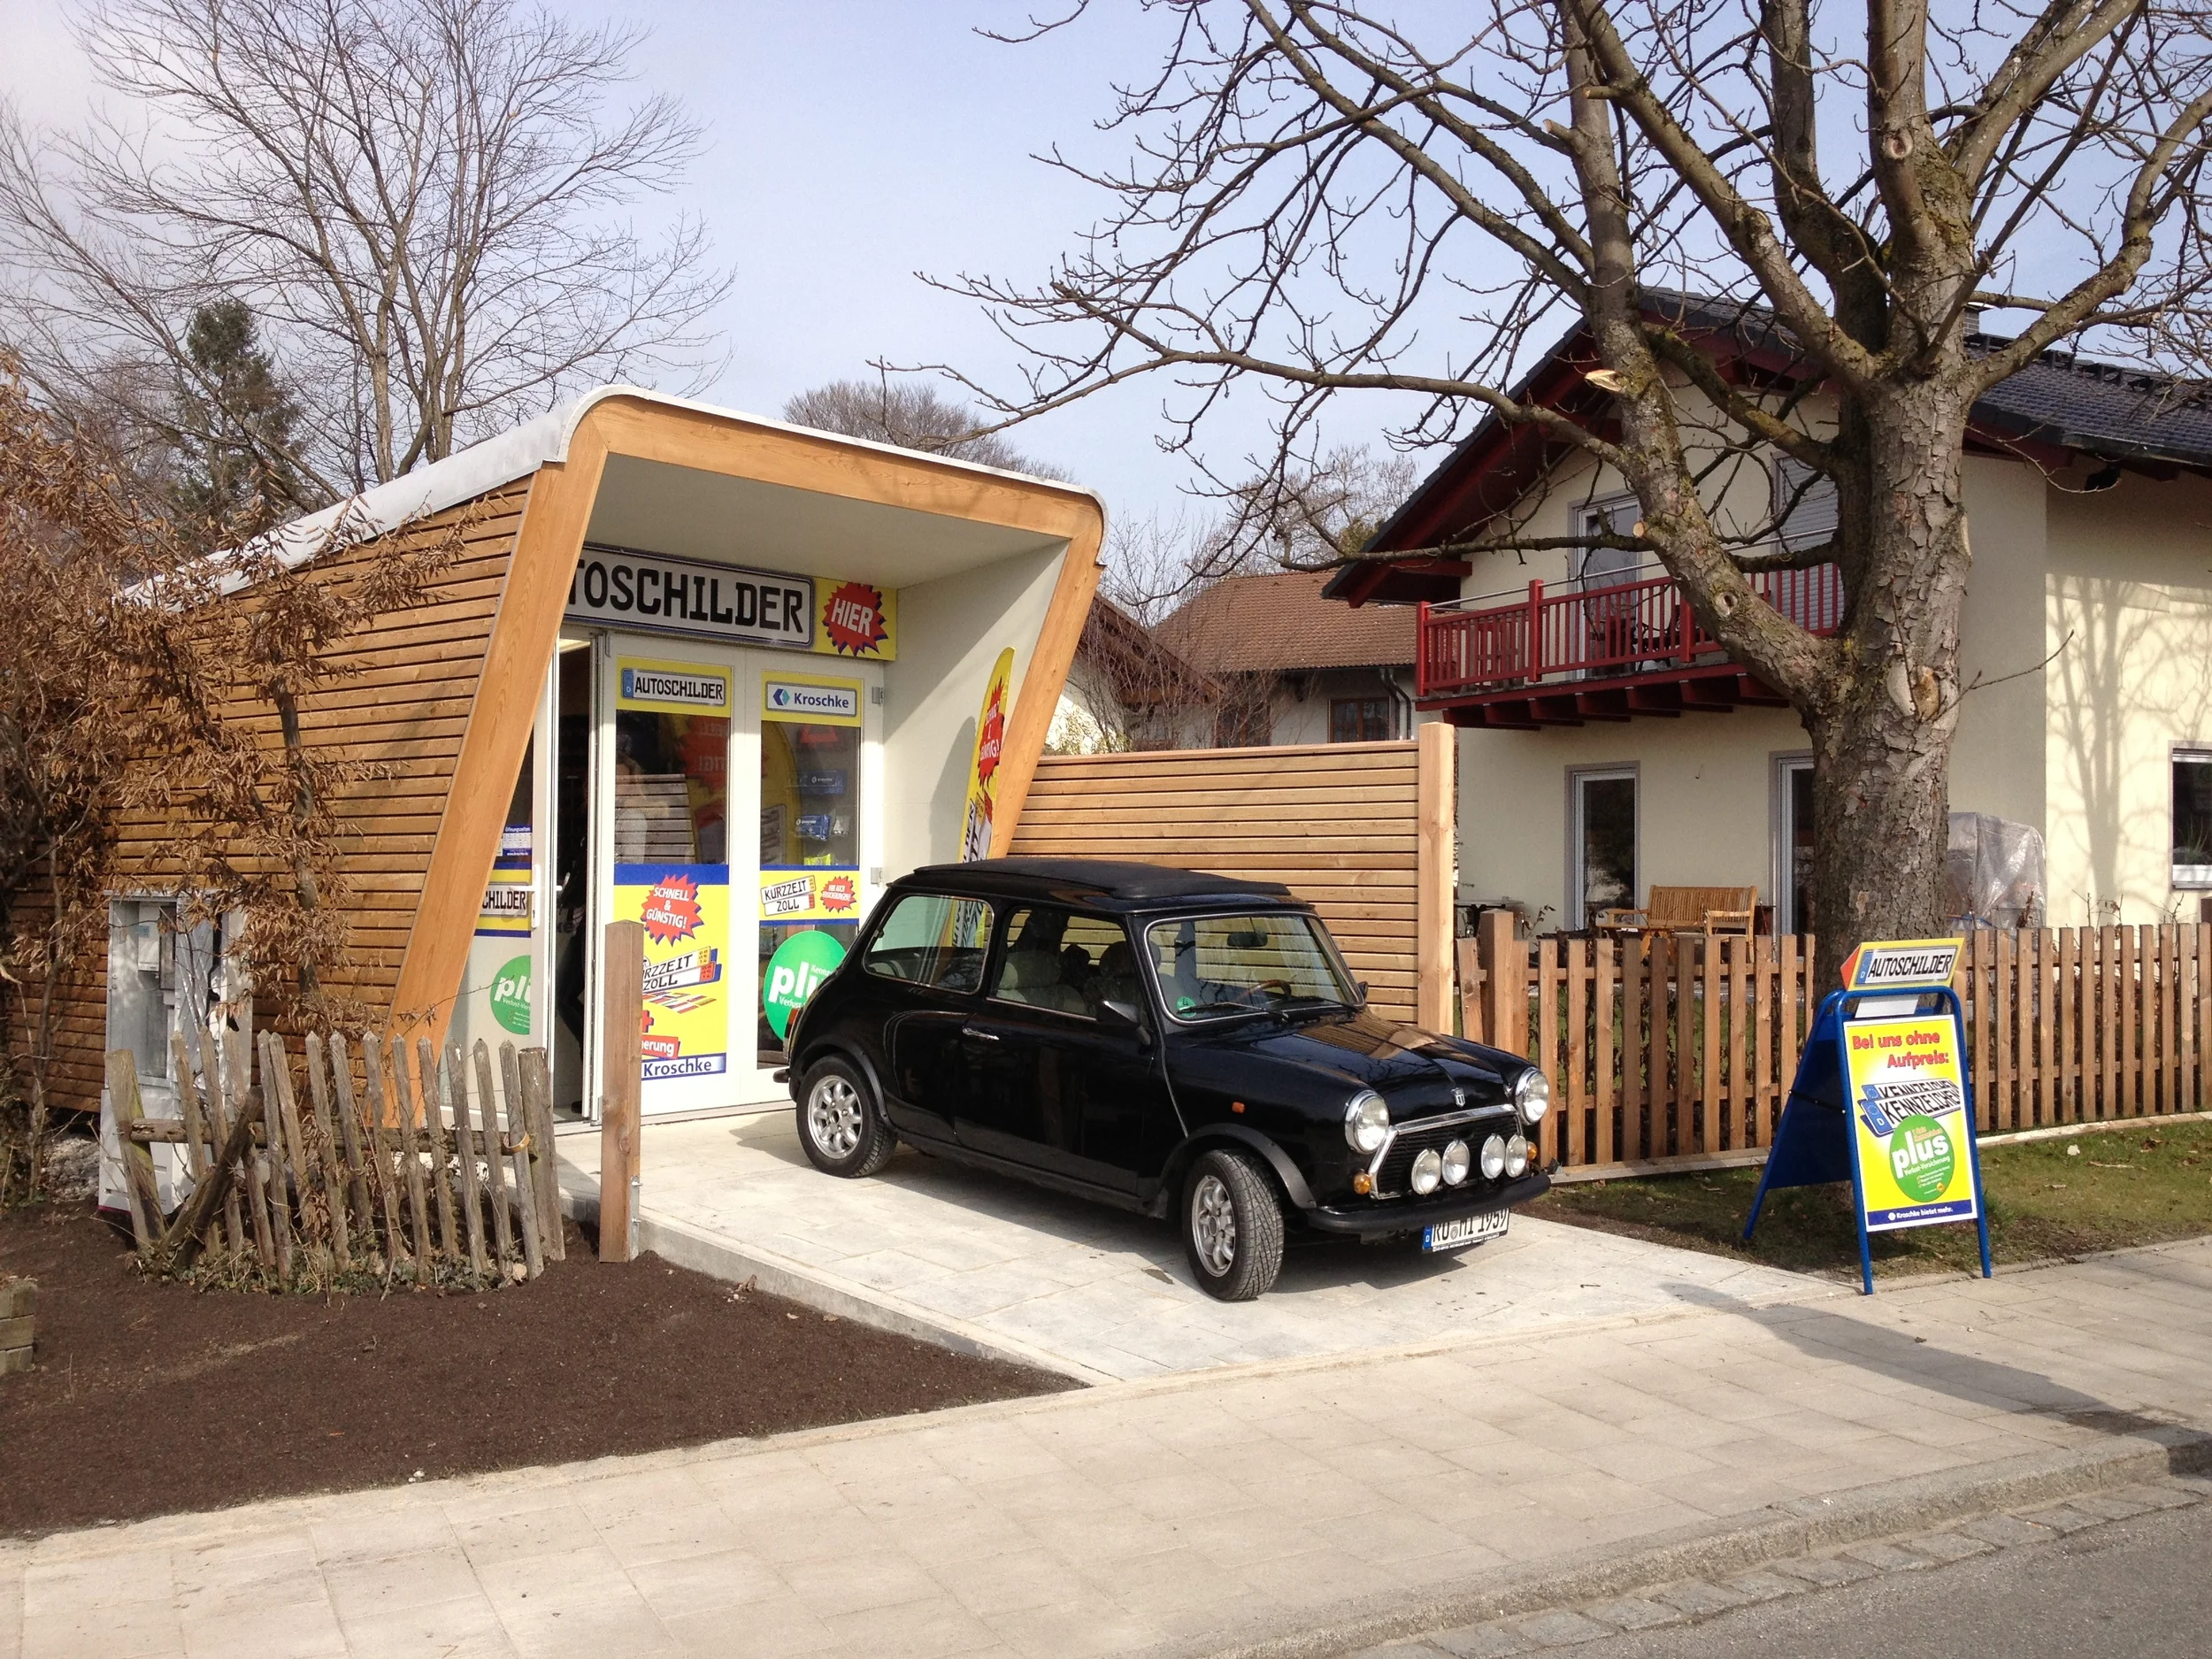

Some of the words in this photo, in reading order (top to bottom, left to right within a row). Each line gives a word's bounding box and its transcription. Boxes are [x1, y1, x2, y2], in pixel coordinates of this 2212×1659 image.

[831, 597, 873, 637] HIER
[634, 677, 724, 701] AUTOSCHILDER
[794, 692, 849, 709] Kroschke
[653, 887, 689, 902] SCHNELL
[764, 880, 807, 901] KURZZEIT
[664, 899, 672, 911] &
[776, 899, 800, 912] ZOLL
[646, 907, 687, 930] GÜNSTIG!
[643, 954, 693, 979] RZZEIT
[1868, 955, 1953, 978] AUTOSCHILDER
[643, 974, 678, 991] ZOLL
[1878, 1034, 1902, 1048] uns
[1905, 1030, 1940, 1046] ohne
[644, 1056, 711, 1077] Kroschke
[1887, 1049, 1949, 1070] Aufpreis:
[1878, 1089, 1961, 1125] KENNZEICHEN
[1877, 1118, 1886, 1126] D
[1892, 1130, 1949, 1179] plus
